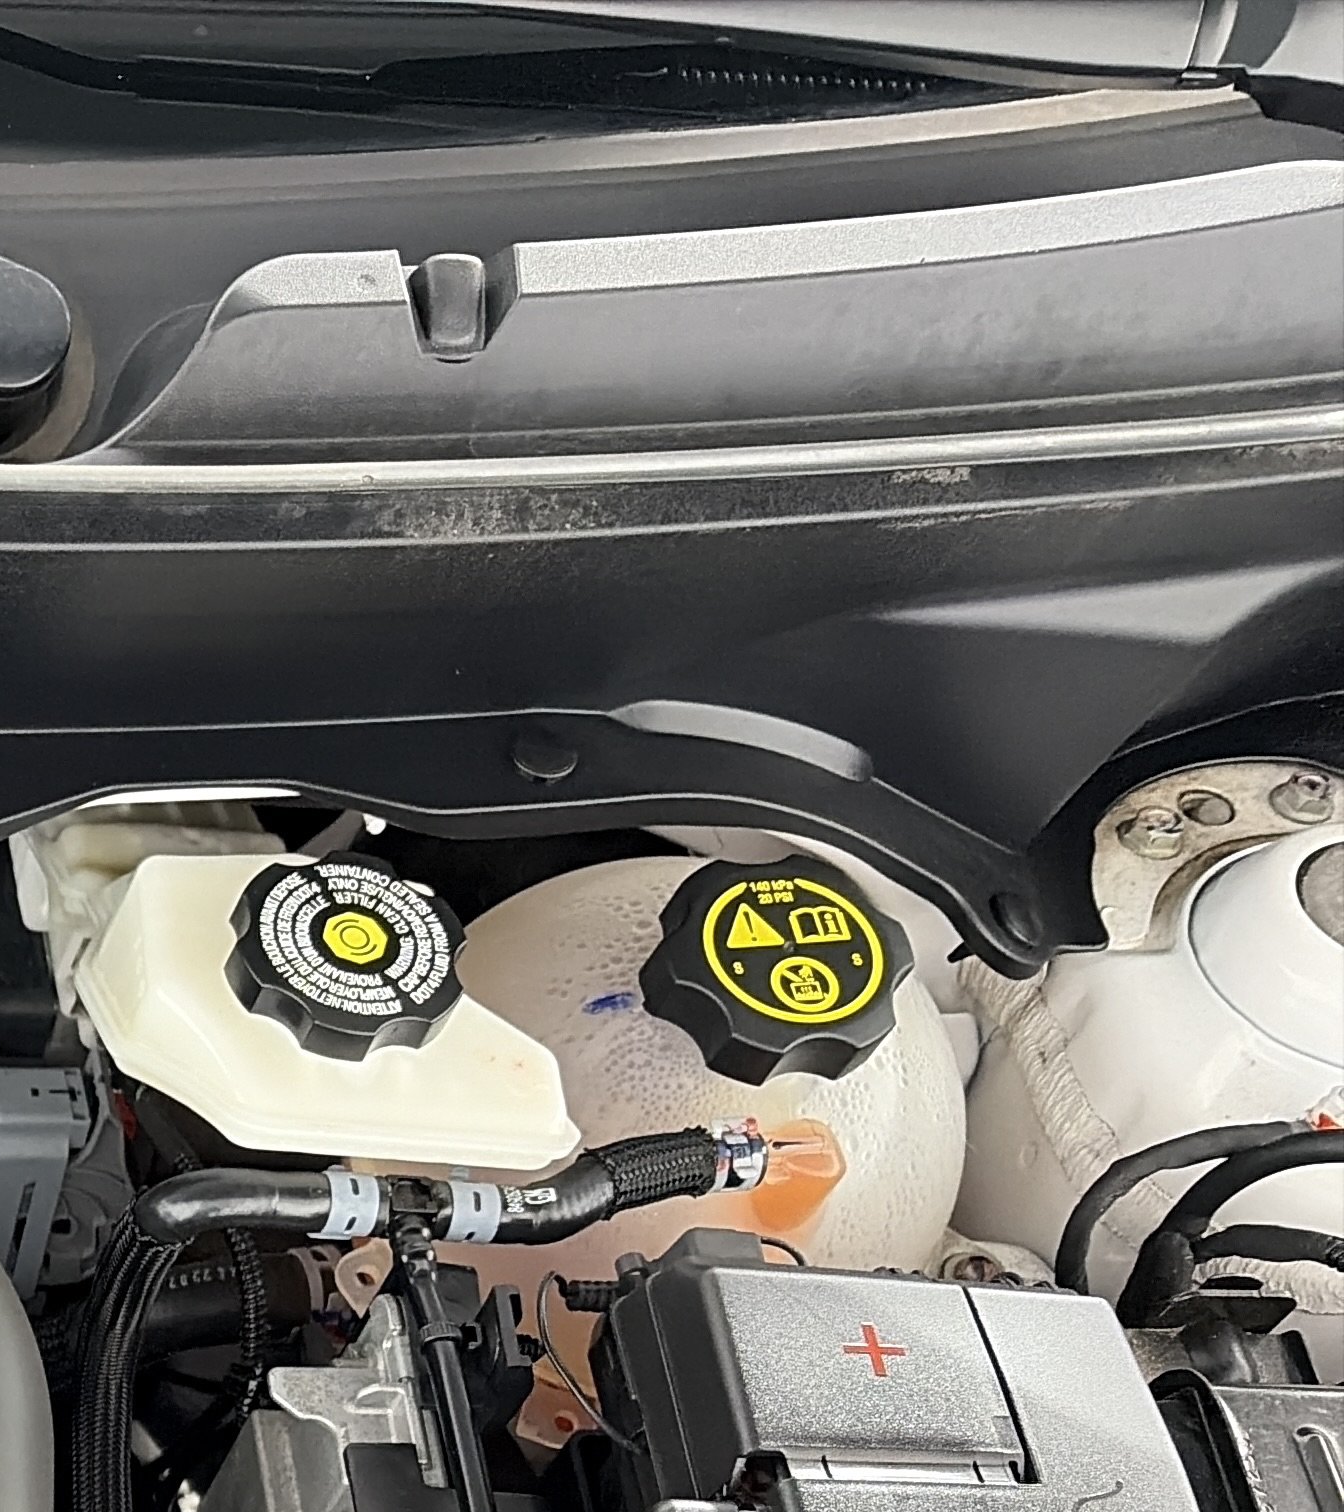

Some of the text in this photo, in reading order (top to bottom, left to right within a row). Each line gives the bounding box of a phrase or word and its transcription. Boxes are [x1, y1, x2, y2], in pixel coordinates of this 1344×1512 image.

[327, 877, 359, 891] ONLY
[359, 880, 385, 899] USE
[749, 880, 771, 893] 140
[332, 891, 378, 910] FILLER
[388, 880, 433, 918] SEALED
[757, 893, 773, 905] 20
[374, 898, 410, 935] CLEAN
[427, 921, 450, 954] FROM
[411, 937, 436, 977] BEFORE
[275, 962, 296, 979] LE
[397, 970, 421, 993] CAP
